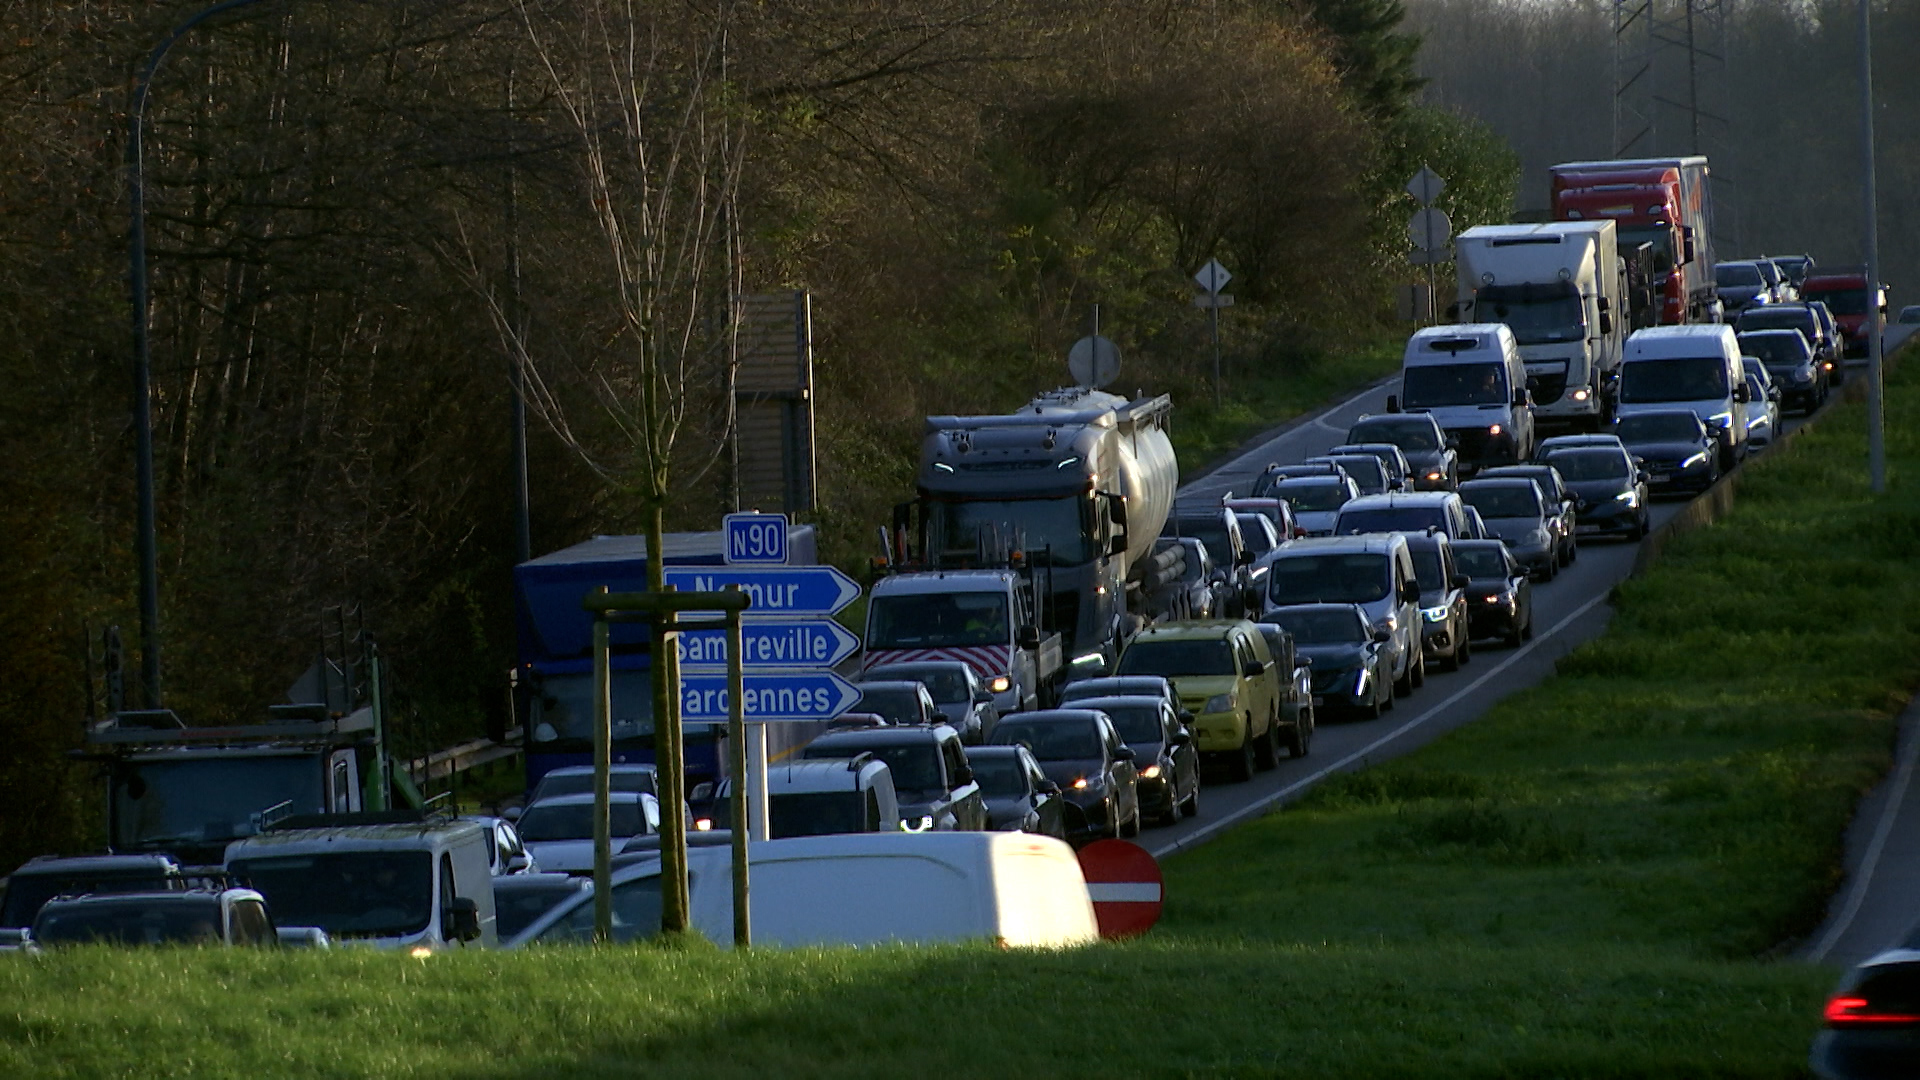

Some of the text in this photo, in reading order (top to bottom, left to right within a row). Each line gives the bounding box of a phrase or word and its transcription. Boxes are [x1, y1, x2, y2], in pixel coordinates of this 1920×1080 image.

[734, 523, 779, 556] N90
[695, 576, 799, 608] Nmur
[678, 628, 828, 660] Samreville
[681, 681, 831, 714] arcennes
